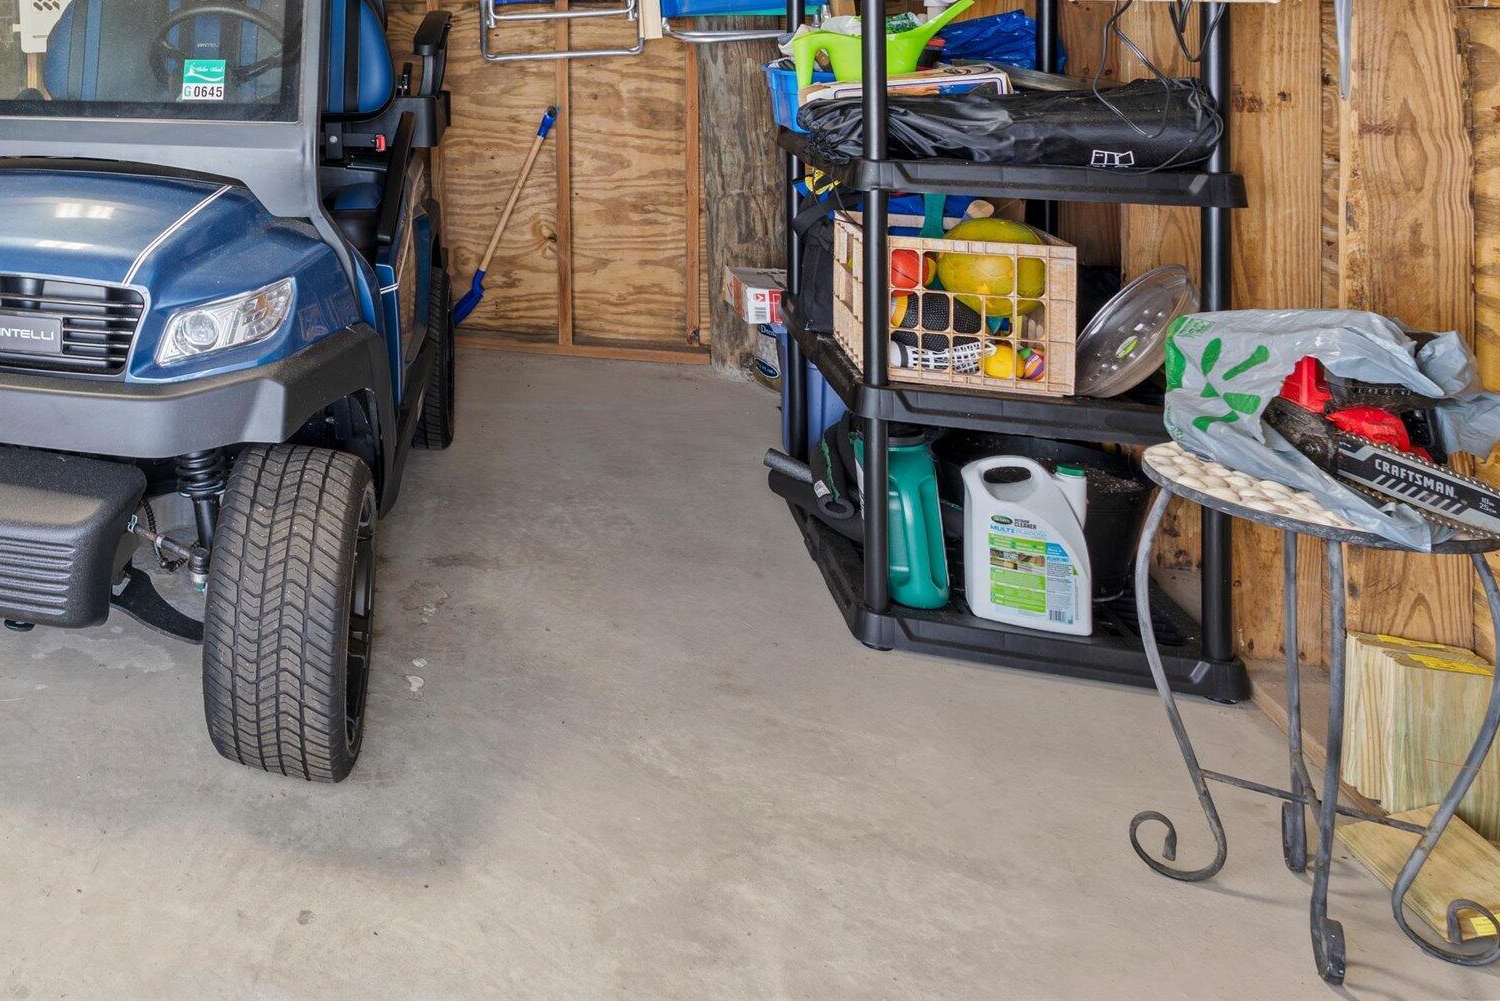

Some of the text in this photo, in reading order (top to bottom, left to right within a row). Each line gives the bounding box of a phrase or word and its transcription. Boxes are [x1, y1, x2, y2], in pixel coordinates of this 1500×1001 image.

[183, 85, 223, 98] G 0645
[1374, 458, 1456, 499] CRAFTSMAN
[1013, 522, 1037, 531] CLEANER
